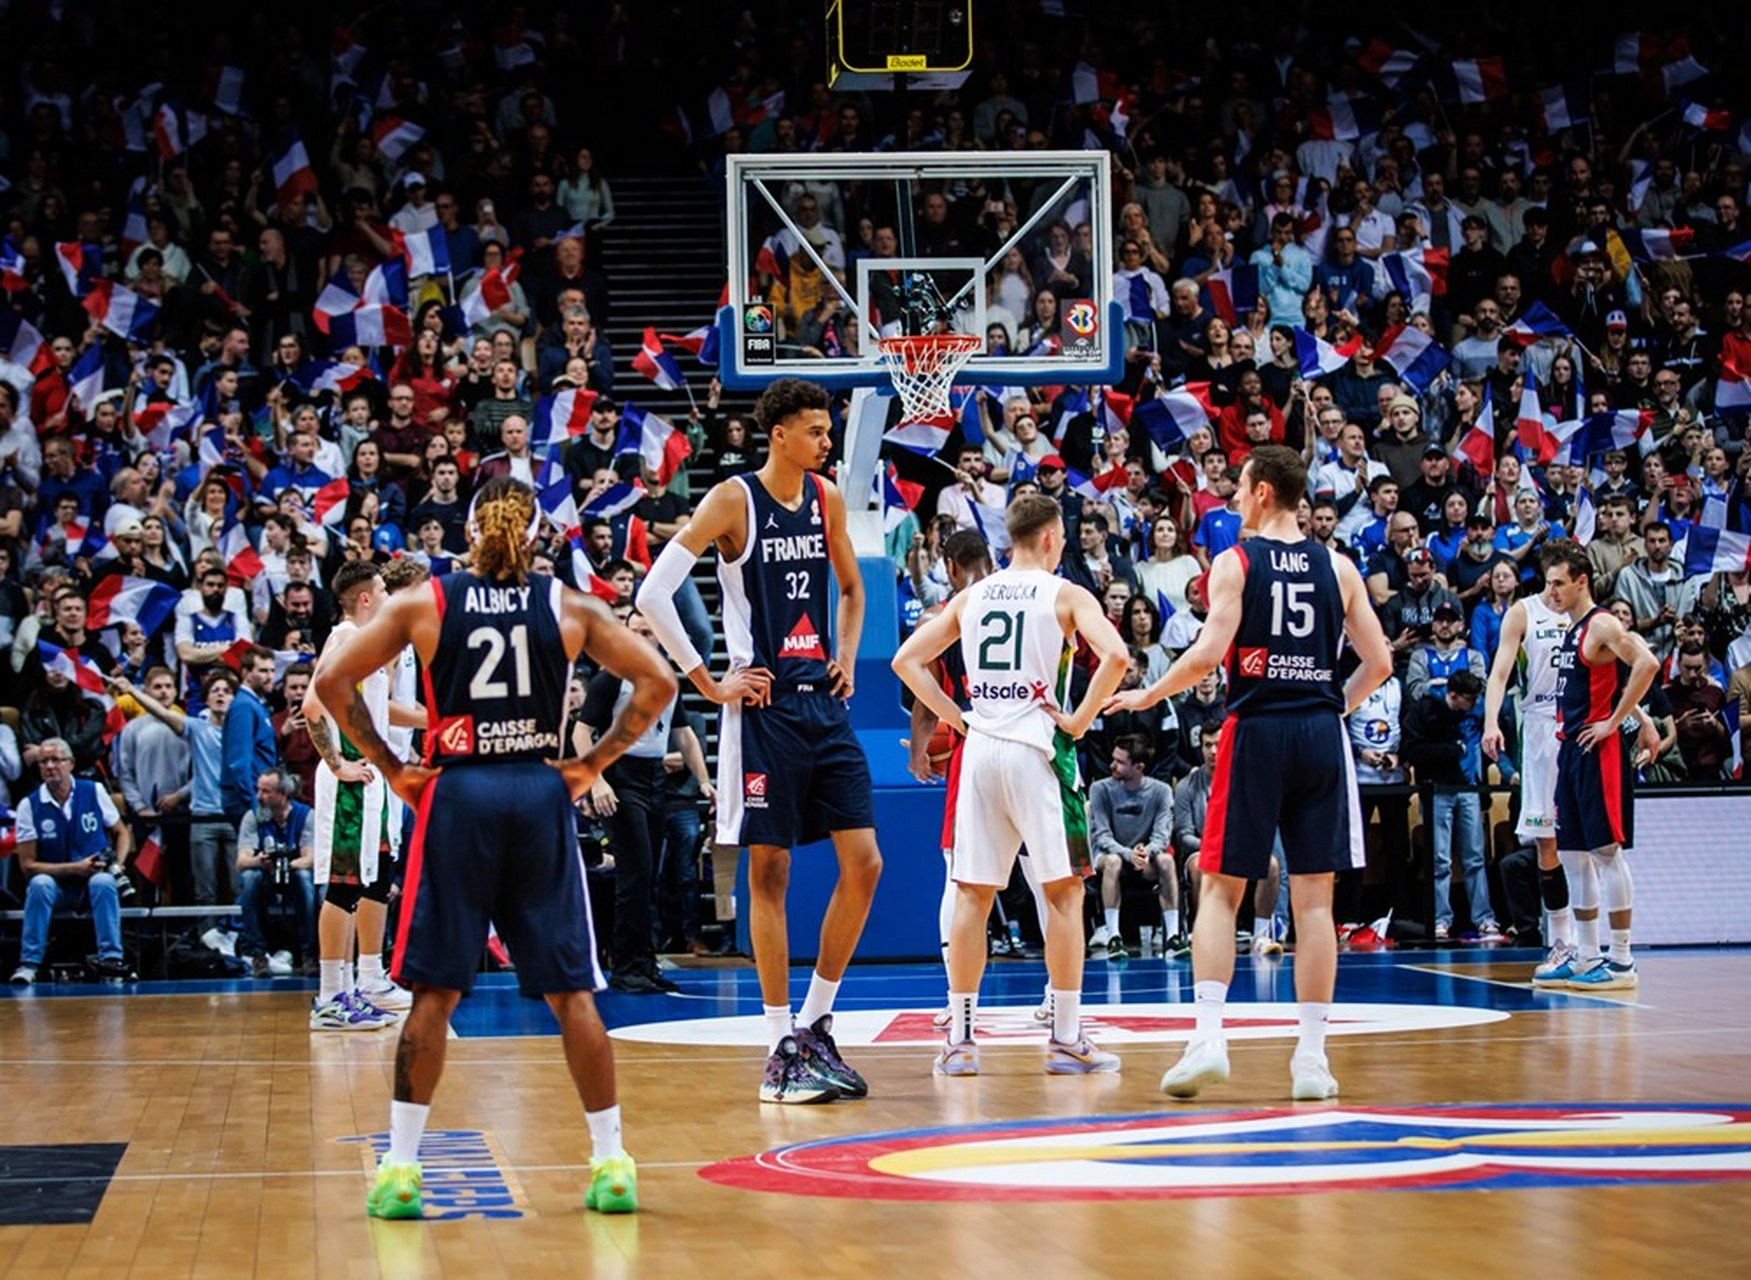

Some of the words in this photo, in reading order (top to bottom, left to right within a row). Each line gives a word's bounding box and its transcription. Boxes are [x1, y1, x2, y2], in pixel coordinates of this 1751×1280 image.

[748, 338, 771, 351] FIBA
[761, 533, 826, 563] FRANCE
[1270, 549, 1309, 572] LANG
[785, 570, 811, 600] 32
[465, 586, 531, 613] ALBICY
[1271, 580, 1315, 637] 15
[784, 634, 819, 651] MAIF
[979, 610, 1025, 670] 21
[467, 624, 532, 699] 21
[1268, 655, 1315, 668] CAISSE
[797, 684, 814, 692] FRA
[972, 682, 1029, 699] etsafe
[477, 718, 537, 738] CAISSE
[81, 811, 98, 833] 05
